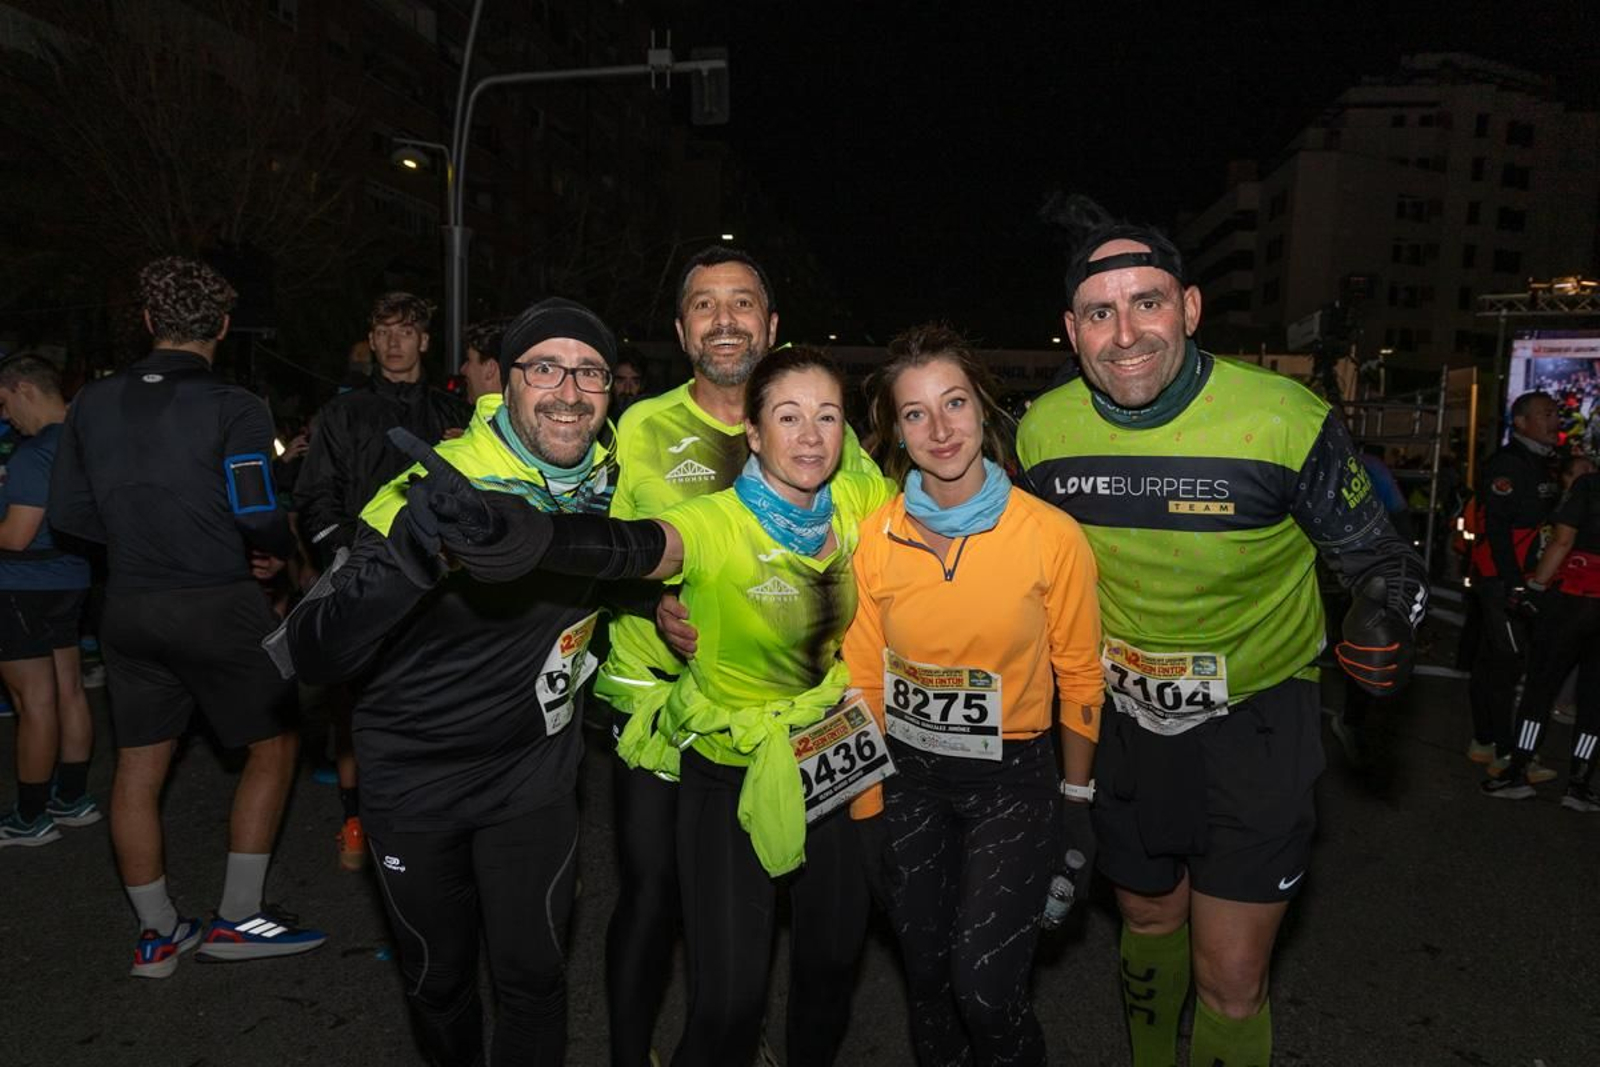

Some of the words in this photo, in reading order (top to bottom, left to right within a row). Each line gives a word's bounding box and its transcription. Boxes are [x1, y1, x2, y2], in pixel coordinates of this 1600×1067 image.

[1055, 476, 1230, 500] LOVEBURPEES
[1174, 502, 1230, 513] TEAM
[892, 678, 989, 724] 8275
[1110, 663, 1216, 711] 7104
